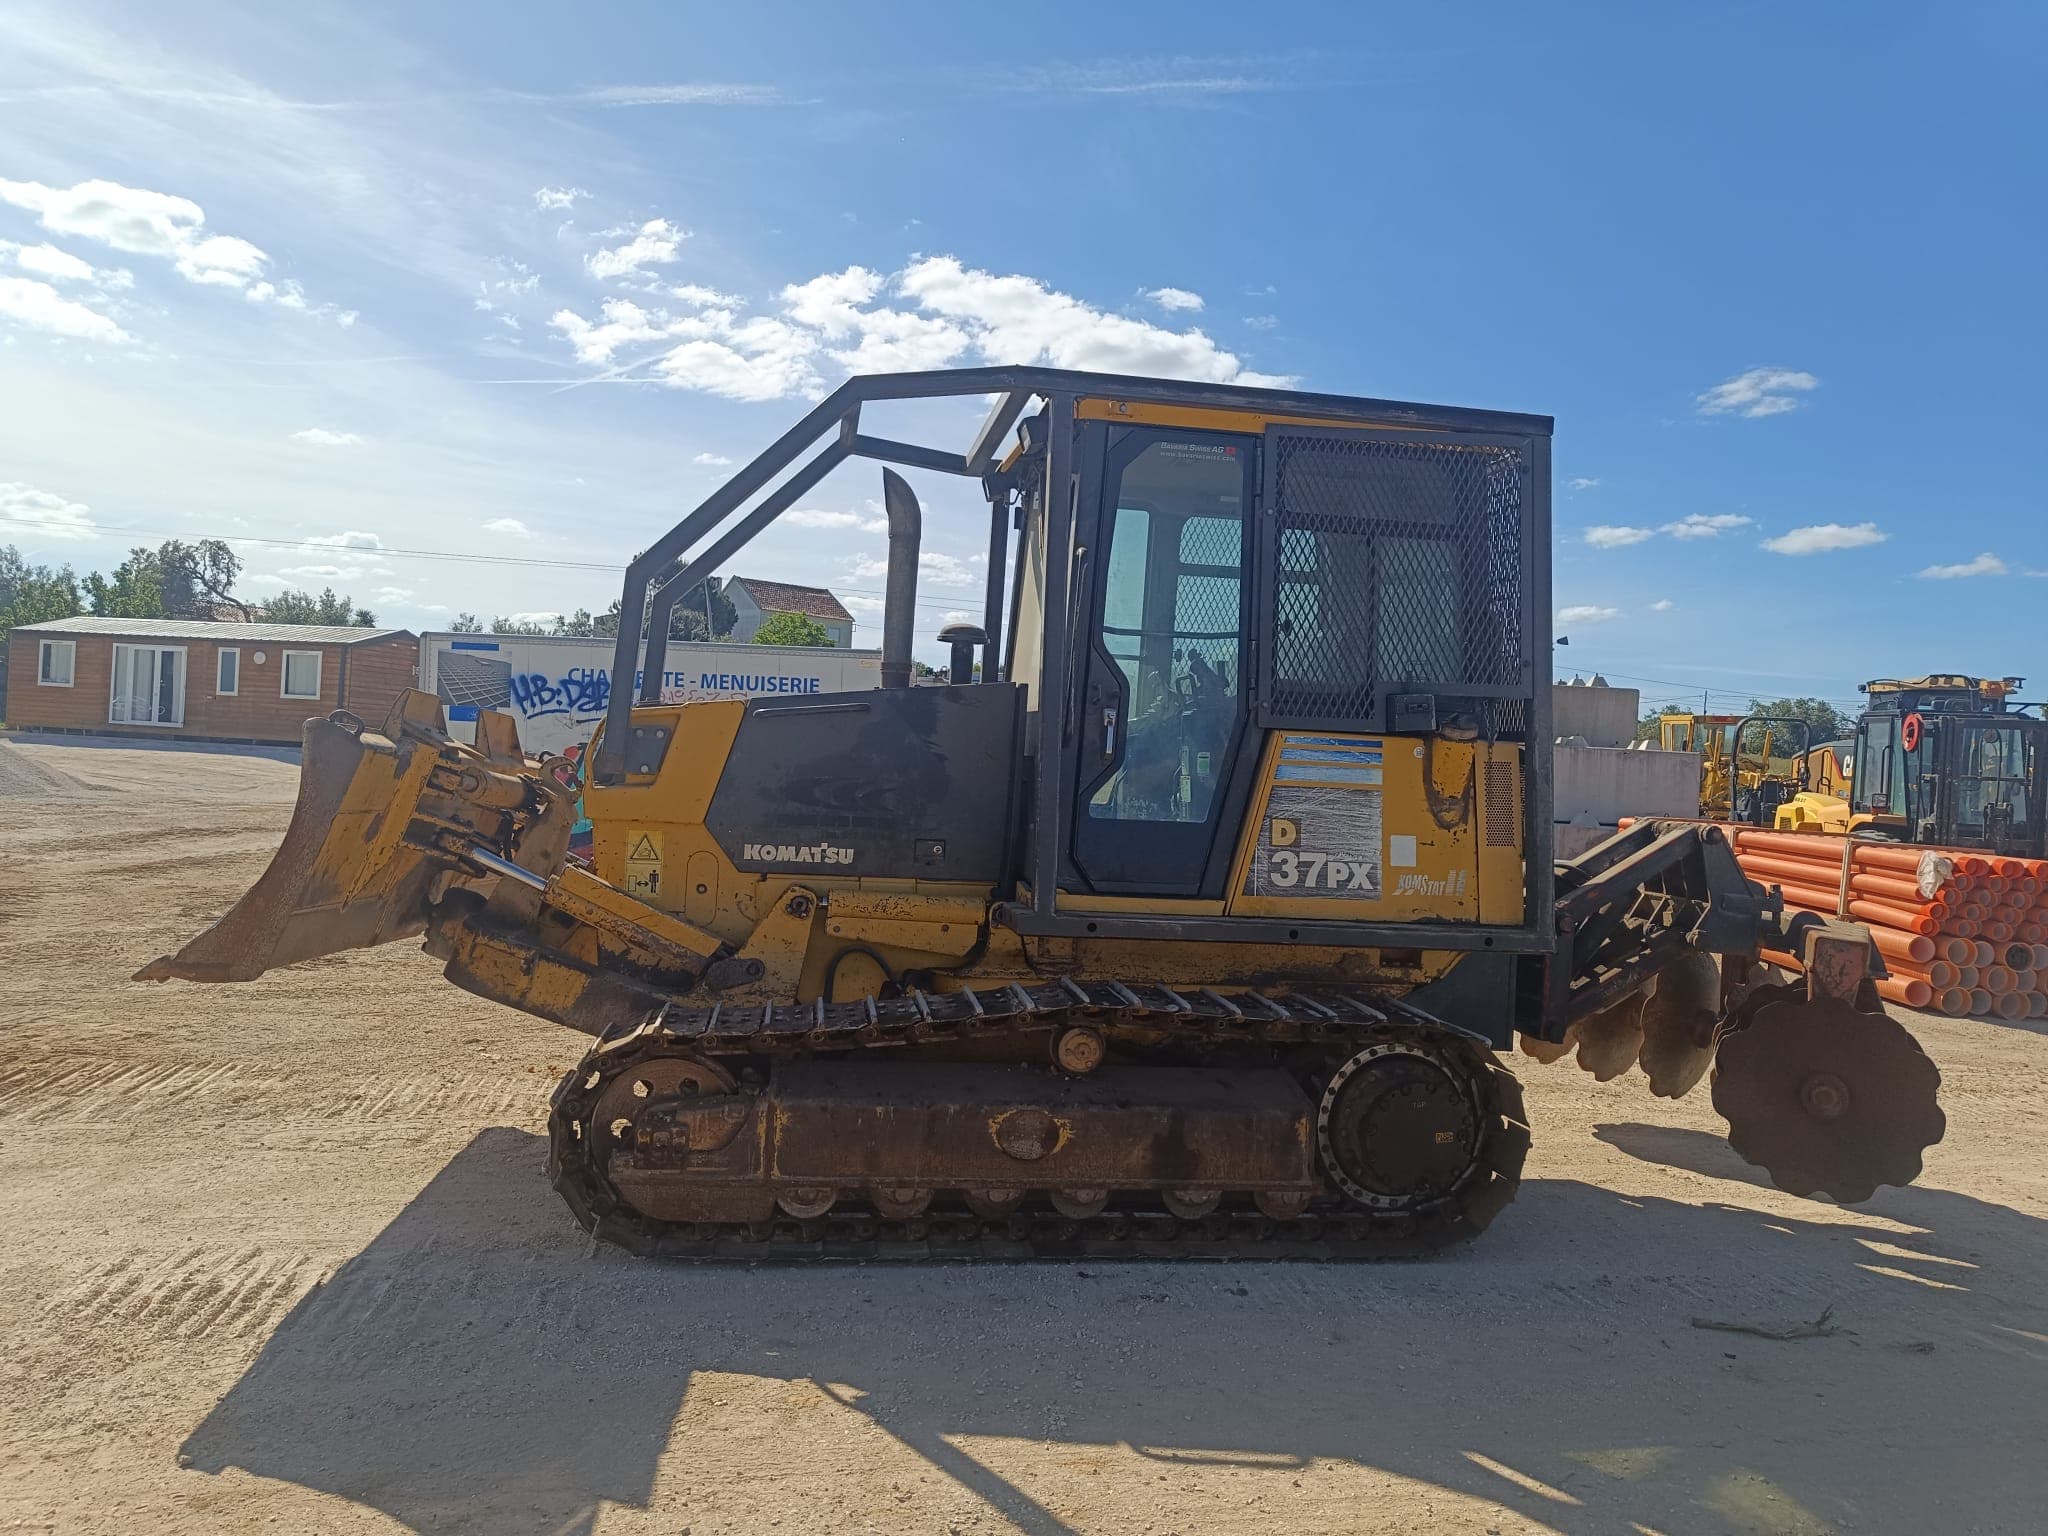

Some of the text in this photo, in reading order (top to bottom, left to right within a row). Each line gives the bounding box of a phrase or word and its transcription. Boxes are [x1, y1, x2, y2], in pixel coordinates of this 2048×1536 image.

[701, 673, 820, 693] MENUISERIE
[1270, 818, 1297, 846] D
[743, 842, 854, 864] KOMATSU
[1270, 851, 1373, 890] 37PX
